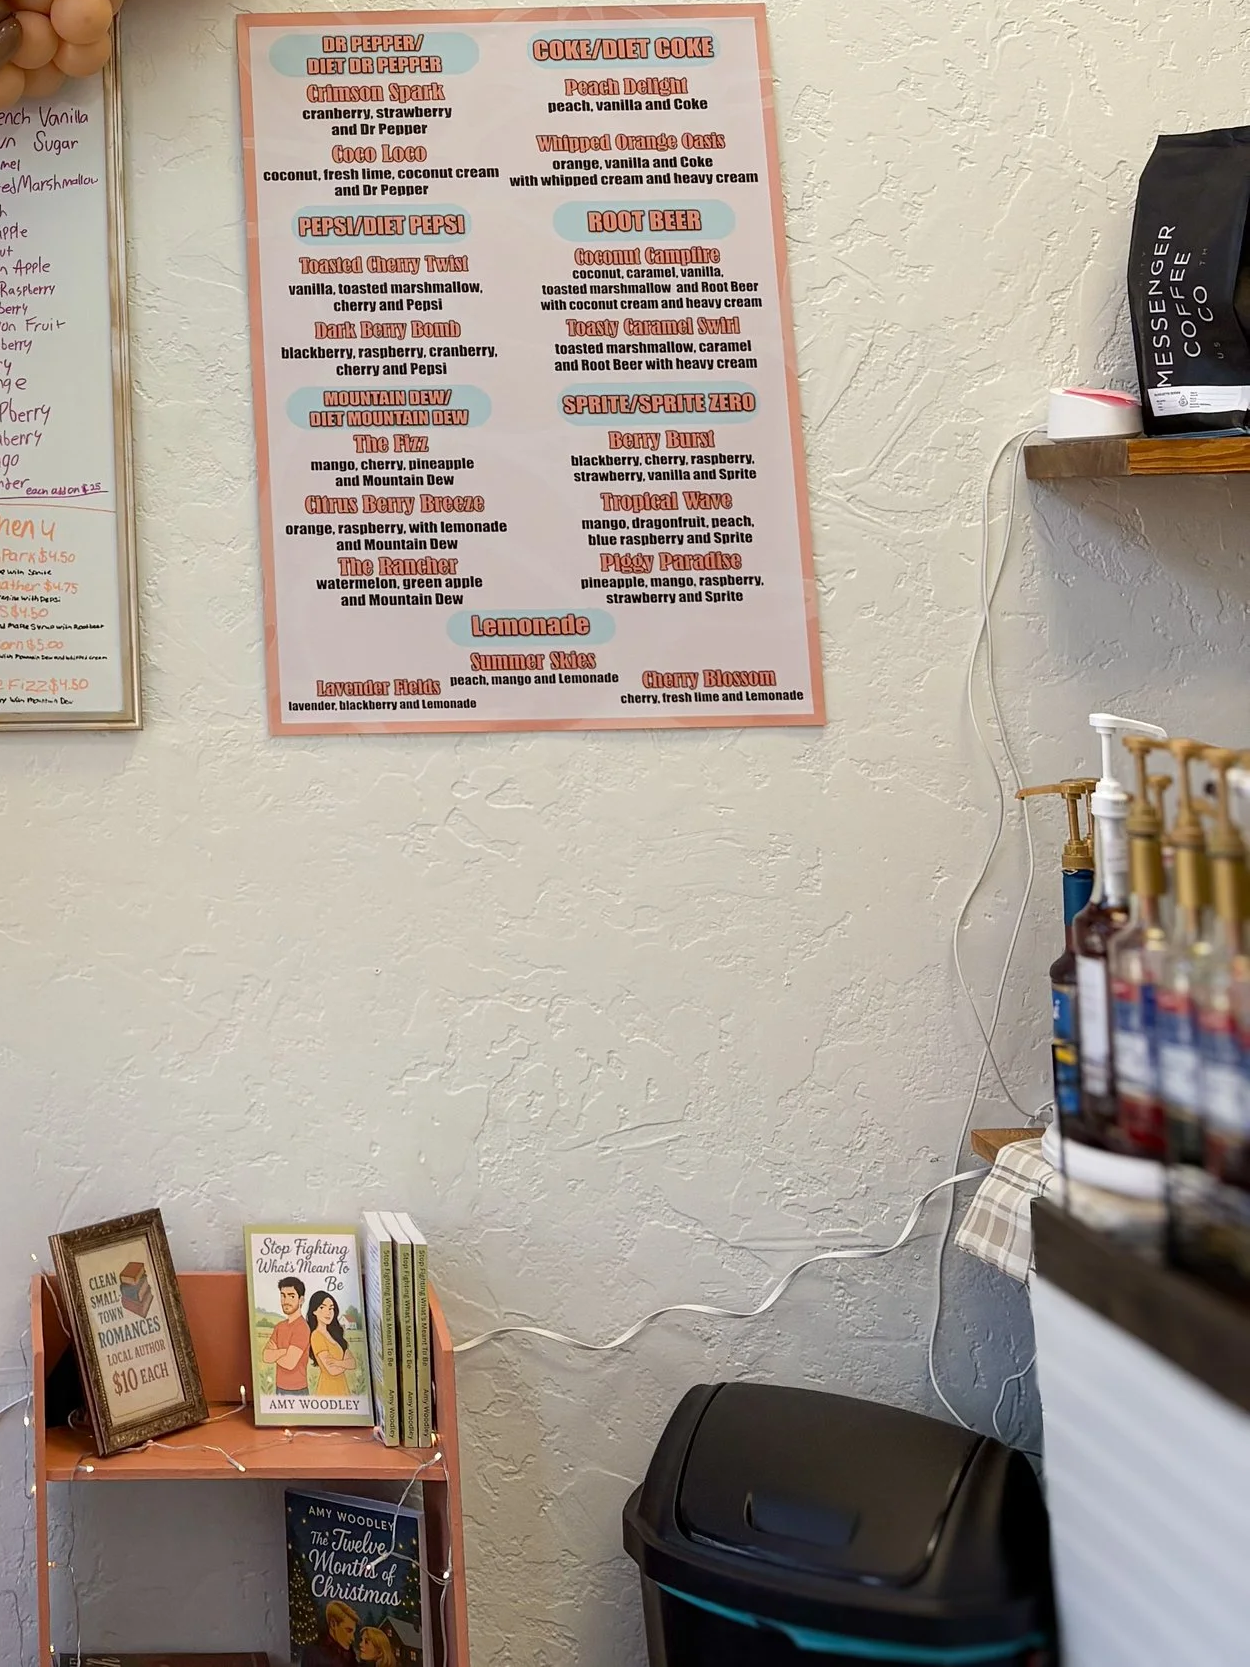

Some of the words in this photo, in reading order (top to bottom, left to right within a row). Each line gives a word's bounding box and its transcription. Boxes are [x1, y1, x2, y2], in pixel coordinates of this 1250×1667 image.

[321, 35, 348, 54] DR
[350, 33, 424, 53] PEPPER/
[532, 37, 651, 62] COKE/DIET
[654, 36, 715, 60] COKE
[306, 57, 347, 76] DIET
[348, 56, 375, 75] DR
[376, 55, 443, 74] PEPPER
[306, 83, 384, 103] Crimson
[388, 82, 446, 104] Spark
[564, 77, 621, 97] Peach
[622, 76, 689, 97] Delight
[39, 106, 89, 127] Vanilla
[302, 107, 374, 120] cranberry,
[376, 106, 452, 119] strawberry
[547, 100, 594, 114] peach,
[595, 98, 643, 112] vanilla
[645, 98, 671, 111] and
[673, 98, 708, 111] Coke
[331, 123, 358, 136] and
[360, 123, 376, 135] Dr
[378, 123, 428, 136] Pepper
[33, 130, 79, 155] Sugar
[535, 133, 613, 154] Whipped
[614, 132, 678, 152] Orange
[681, 132, 726, 150] Oasis
[331, 144, 377, 164] Coco
[381, 143, 427, 163] Loco
[298, 214, 407, 238] PEPSI/DIET
[408, 214, 466, 236] PEPSI
[587, 209, 646, 233] ROOT
[648, 209, 702, 232] BEER
[13, 256, 51, 277] Apple
[298, 256, 364, 275] Toasted
[366, 255, 421, 276] Cherry
[424, 254, 470, 273] Twist
[573, 247, 642, 266] Coconut
[644, 246, 721, 267] Campfire
[1148, 225, 1176, 388] MESSENGER
[1170, 252, 1201, 357] COFFEE
[1193, 285, 1214, 322] CO
[25, 316, 66, 332] Fruit
[314, 321, 358, 340] Dark
[359, 320, 408, 341] Berry
[410, 319, 462, 339] Bomb
[565, 318, 620, 339] Toasty
[623, 316, 695, 336] Caramel
[696, 316, 741, 335] Swirl
[323, 390, 407, 407] MOUNTAIN
[408, 389, 452, 407] DEW/
[561, 392, 707, 415] SPRITE/SPRITE
[707, 392, 757, 413] ZERO
[309, 410, 345, 428] DIET
[346, 409, 430, 427] MOUNTAIN
[431, 409, 469, 426] DEW
[352, 434, 389, 454] The
[392, 433, 430, 453] Fizz
[608, 430, 661, 452] Berry
[665, 429, 716, 449] Burst
[304, 494, 359, 515] Citrus
[361, 494, 416, 516] Berry
[419, 493, 485, 514] Breeze
[599, 491, 679, 514] Tropical
[681, 490, 733, 511] Wave
[337, 557, 374, 577] The
[378, 557, 459, 576] Rancher
[599, 552, 655, 575] Piggy
[658, 550, 742, 572] Paradise
[470, 613, 591, 638] Lemonade
[470, 652, 545, 672] Summer
[549, 651, 597, 670] Skies
[316, 679, 391, 697] Lavender
[393, 678, 441, 696] Fields
[641, 670, 700, 691] Cherry
[702, 669, 777, 688] Blossom
[288, 700, 338, 711] lavender,
[339, 699, 398, 711] blackberry
[399, 699, 420, 710] and
[421, 698, 477, 709] Lemonade
[620, 693, 661, 705] cherry,
[662, 692, 693, 703] fresh
[694, 691, 720, 703] lime
[721, 690, 744, 702] and
[745, 690, 804, 702] Lemonade
[260, 1237, 291, 1260] Stop
[294, 1238, 349, 1261] Fighting
[256, 1258, 295, 1273] What's
[296, 1258, 335, 1273] Meant
[337, 1261, 350, 1274] To
[88, 1272, 117, 1291] CLEAN
[325, 1276, 344, 1291] Be
[98, 1306, 124, 1324] TOWN
[98, 1316, 161, 1349] ROMANCES
[107, 1351, 134, 1367] LOCAL
[135, 1339, 166, 1358] AUTHOR
[387, 1359, 393, 1367] Be
[112, 1368, 139, 1397] $10
[141, 1362, 169, 1384] EACH
[269, 1399, 295, 1410] AMY
[299, 1400, 360, 1411] WOODLEY
[309, 1506, 332, 1518] AMY
[311, 1531, 329, 1546] The
[332, 1528, 388, 1555] Twelve
[309, 1549, 378, 1579] Months
[381, 1564, 397, 1587] of
[311, 1575, 401, 1606] Christmas
